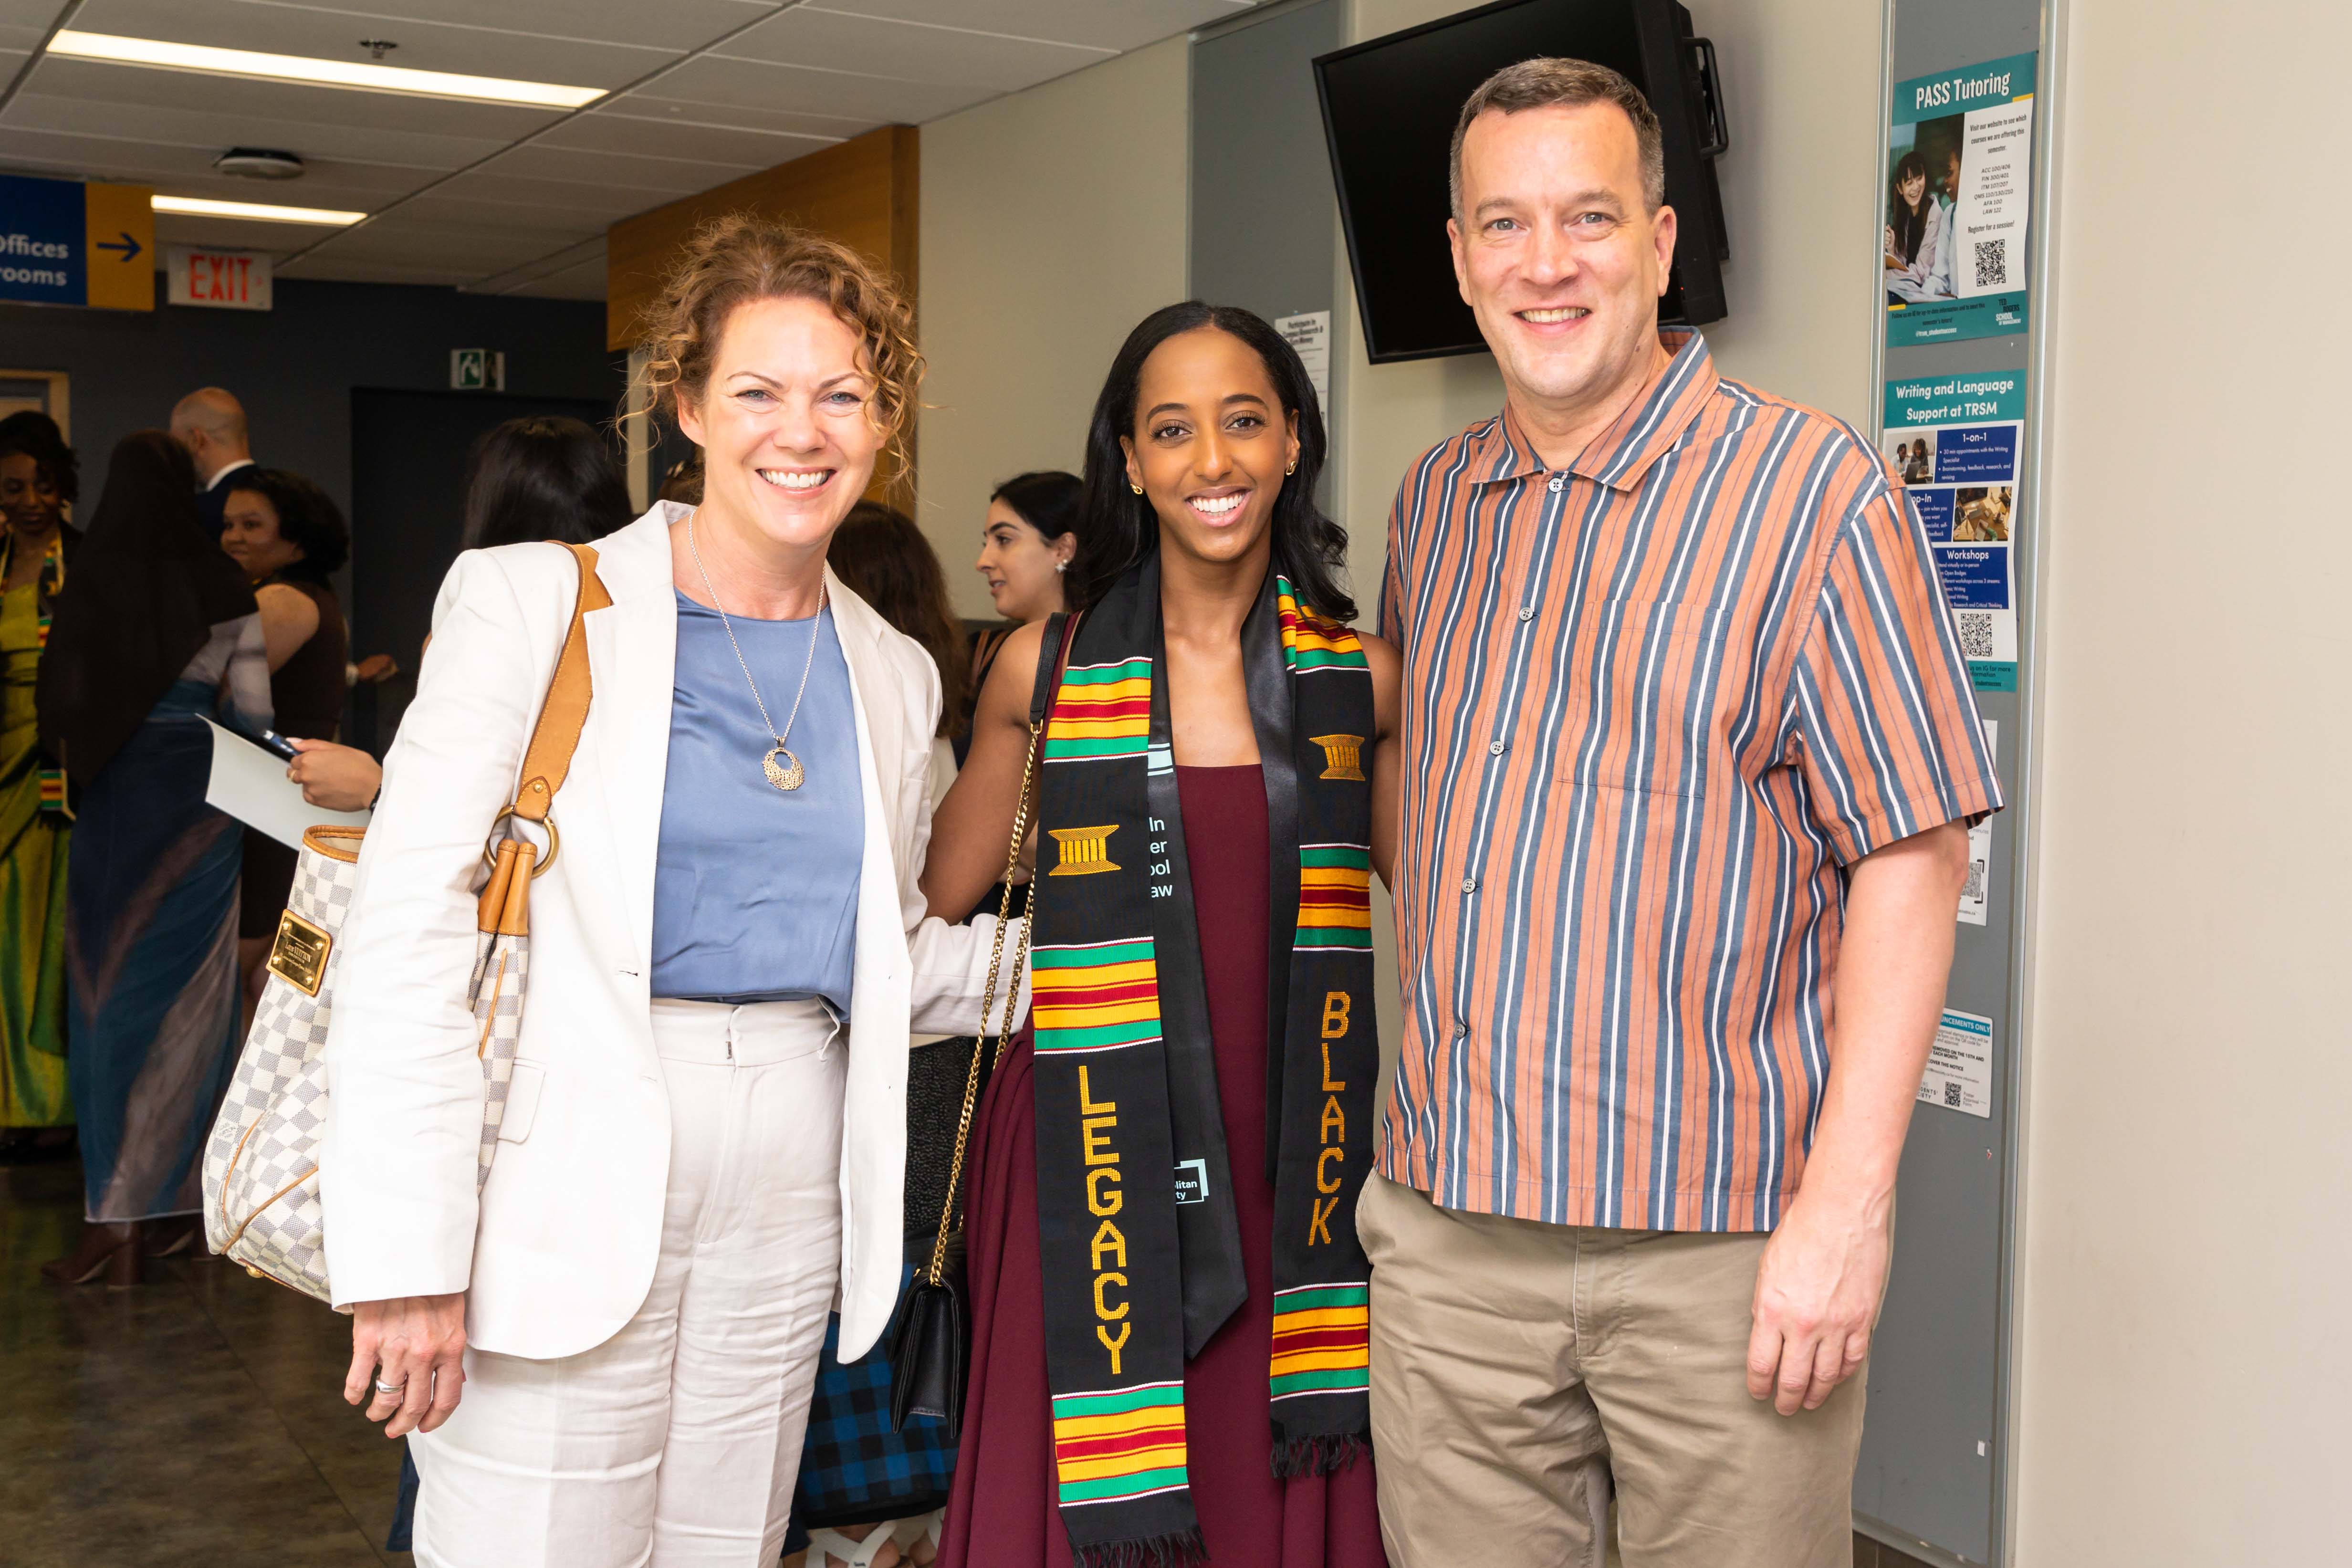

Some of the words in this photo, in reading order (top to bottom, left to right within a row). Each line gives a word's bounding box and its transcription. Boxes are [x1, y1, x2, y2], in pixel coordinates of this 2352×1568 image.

[1916, 81, 1951, 110] PASS
[1954, 73, 2010, 101] Tutoring
[2001, 129, 2017, 138] offering
[1968, 225, 1985, 234] Register
[1997, 220, 2015, 229] session!
[189, 254, 253, 302] EXIT
[2003, 303, 2020, 312] ROGERS
[1996, 312, 2013, 321] SCHOOL
[1896, 385, 1931, 399] Writing
[1934, 381, 1954, 396] and
[1957, 379, 2014, 396] Language
[1906, 406, 1948, 423] Support
[1950, 405, 1961, 417] at
[1964, 401, 1997, 416] TRSM
[1963, 432, 1986, 442] 1-on-1
[1912, 493, 1932, 505] op-In
[1947, 549, 1989, 562] Workshops
[1975, 1024, 1990, 1033] ONLY
[1308, 991, 1350, 1246] BLACK
[1078, 1065, 1131, 1375] LEGACY
